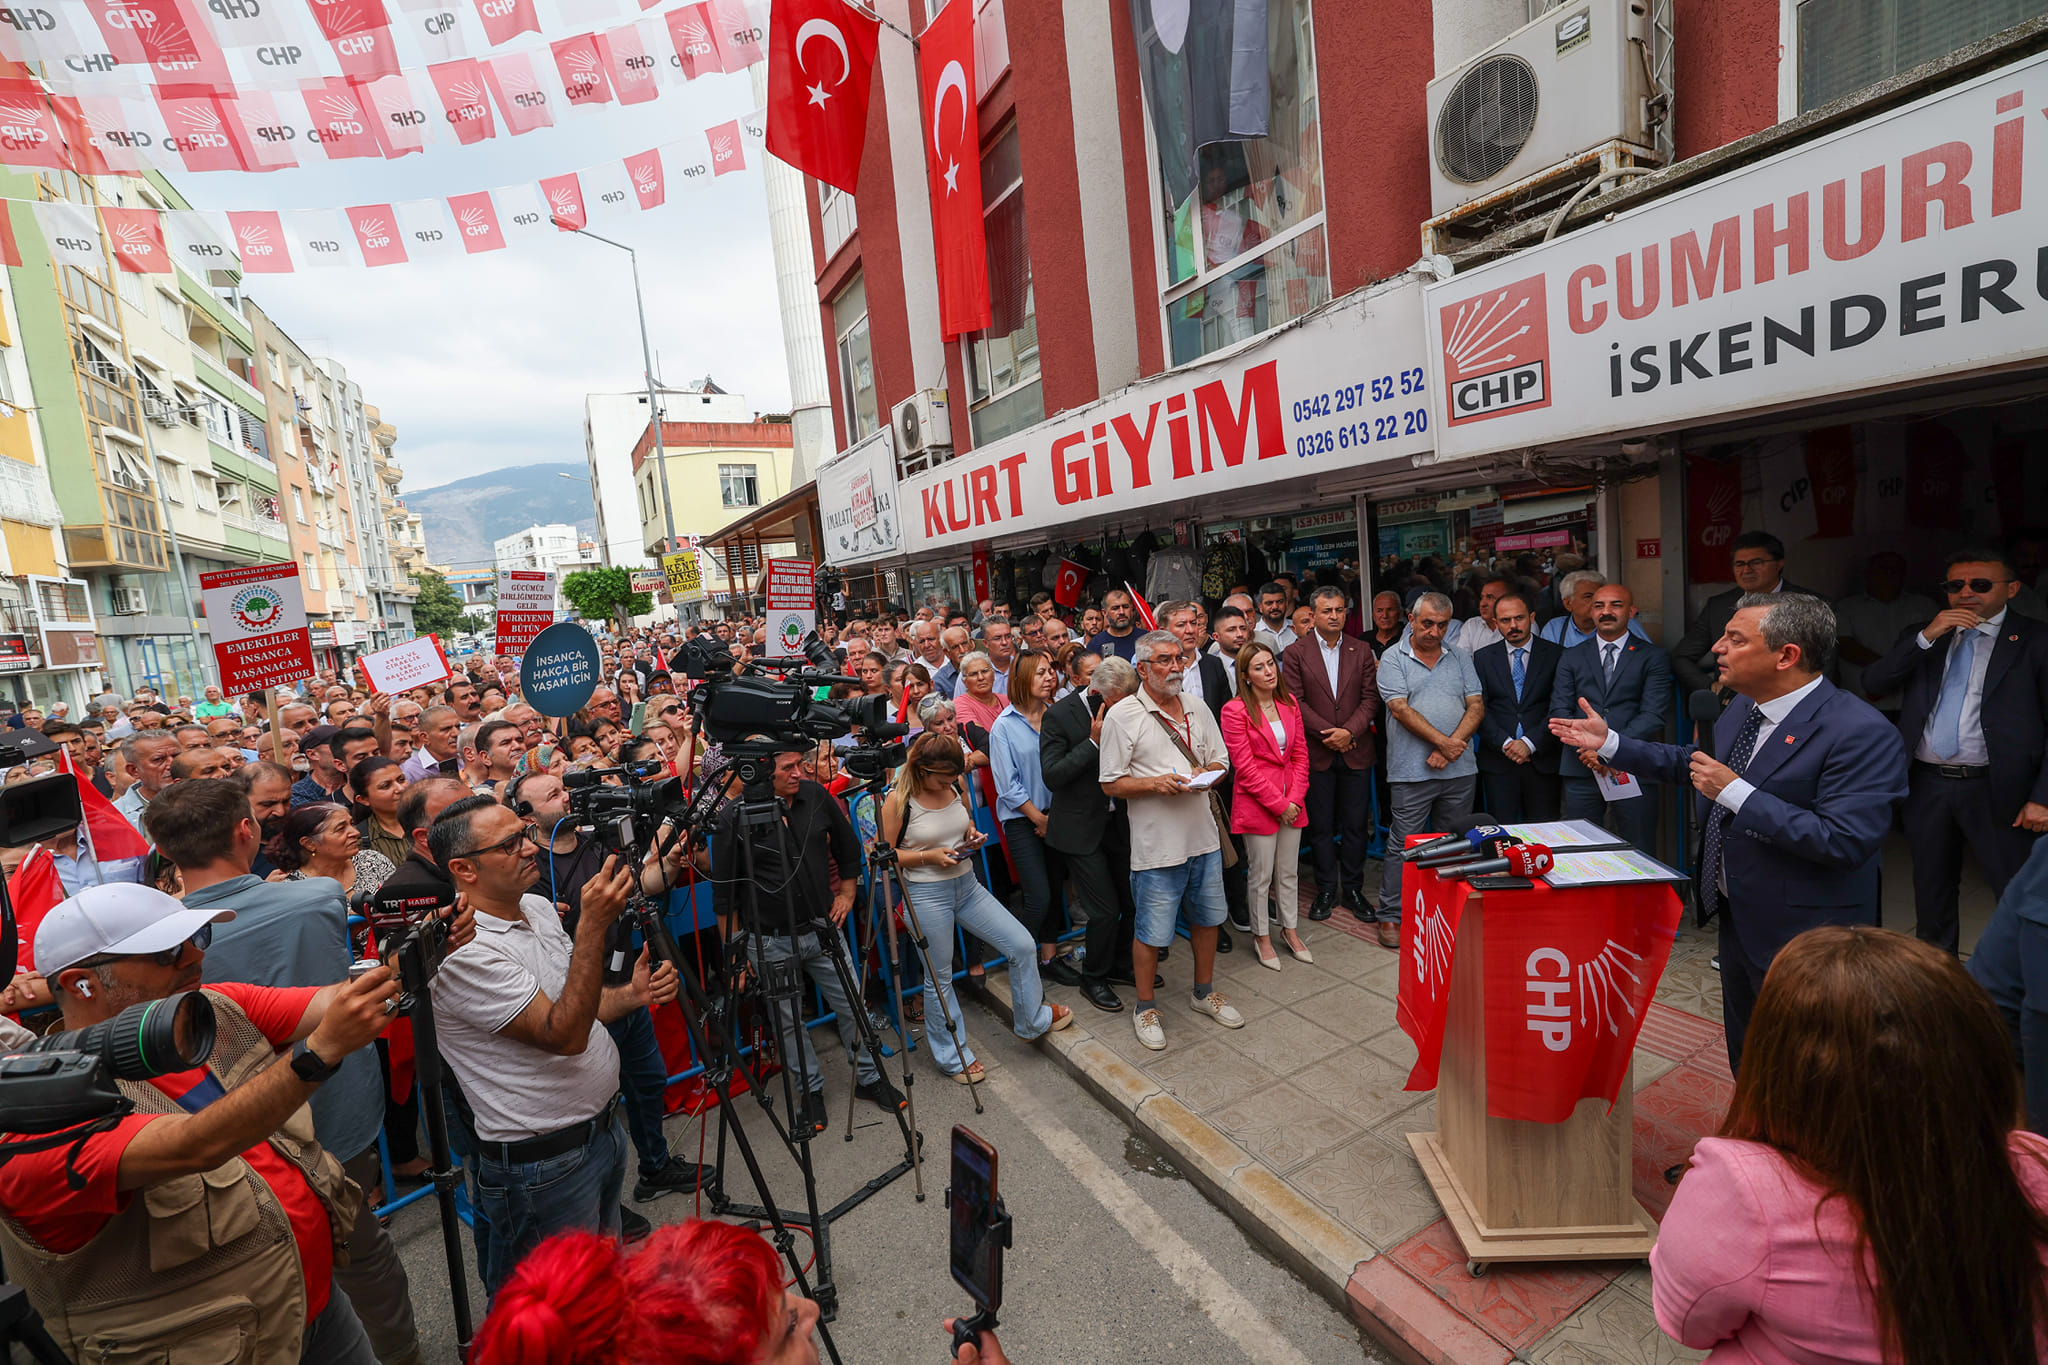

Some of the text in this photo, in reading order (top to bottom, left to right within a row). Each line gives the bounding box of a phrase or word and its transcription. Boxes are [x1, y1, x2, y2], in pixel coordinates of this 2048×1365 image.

[105, 9, 157, 29] CHP
[425, 13, 455, 35] CHP
[338, 36, 375, 56] CHP
[65, 54, 119, 73] CHP
[158, 54, 201, 71] CHP
[257, 46, 302, 66] CHP
[565, 82, 594, 100] CHP
[716, 149, 733, 163] CHP
[639, 180, 658, 195] CHP
[556, 204, 578, 216] CHP
[1567, 89, 2048, 336] CUMHURİ
[466, 223, 490, 237] CHP
[121, 243, 152, 256] CHP
[244, 245, 274, 257] CHP
[365, 236, 391, 249] CHP
[1293, 367, 1425, 424] 0542 297 52 52
[1457, 369, 1538, 412] CHP
[1296, 408, 1428, 459] 0326 613 22 20
[922, 452, 1028, 538] KURT
[1703, 526, 1731, 546] CHP
[1643, 544, 1656, 555] 13
[665, 560, 696, 574] KENT
[668, 570, 700, 585] TAKSİ
[511, 624, 541, 633] BÜTÜN
[226, 632, 300, 654] EMEKLİLER
[240, 647, 292, 665] İNSANCA
[536, 650, 585, 667] İNSANCA,
[232, 658, 302, 680] YAŞANACAK
[264, 668, 310, 687] İSTİYOR
[533, 660, 588, 680] HAKÇA BİR
[532, 672, 591, 693] YAŞAM İÇİN
[383, 897, 437, 909] TRT HABER
[1413, 889, 1425, 983] CHP
[1526, 947, 1572, 1051] CHP
